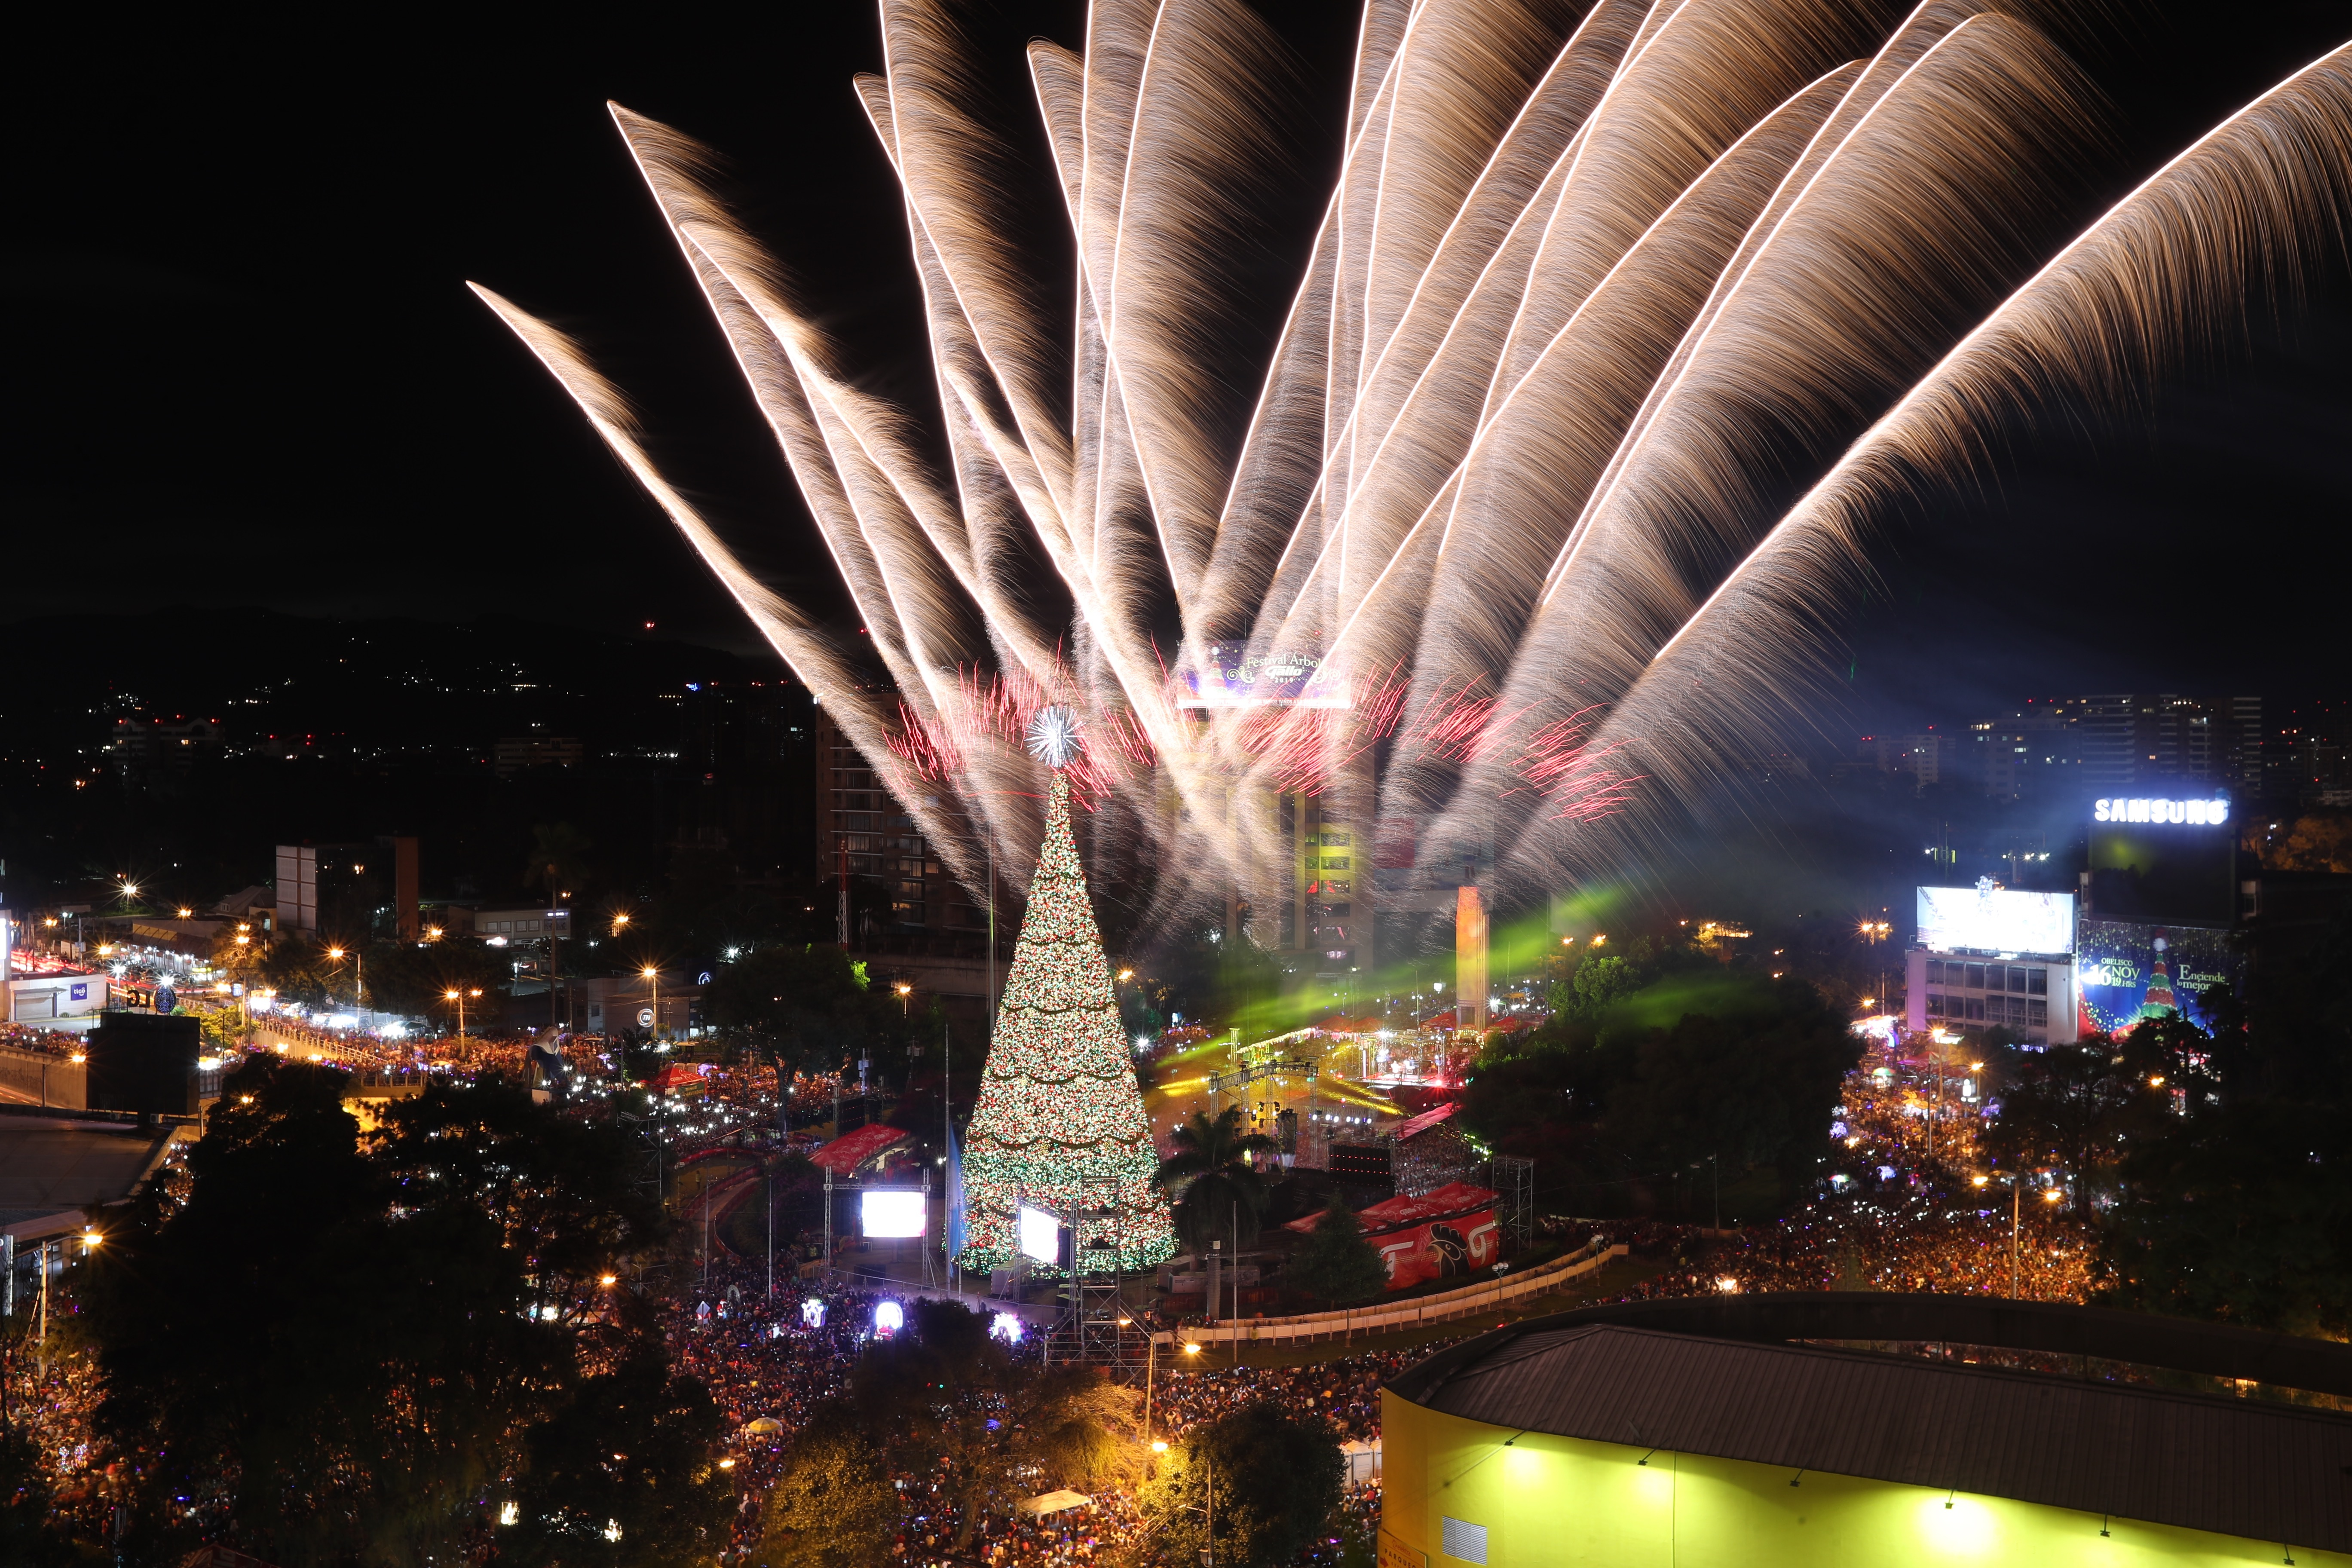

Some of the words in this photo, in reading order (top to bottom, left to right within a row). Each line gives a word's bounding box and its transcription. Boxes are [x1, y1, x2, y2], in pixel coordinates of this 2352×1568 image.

[1246, 654, 1286, 669] Festival
[1290, 652, 1322, 668] Árbol
[1265, 665, 1303, 680] Gallo
[2095, 799, 2225, 825] SAMSUNG
[2101, 958, 2133, 967] OBELISCO
[2090, 964, 2112, 986] 16
[2112, 965, 2140, 980] NOV
[2179, 964, 2226, 983] Enciende
[2122, 980, 2136, 988] HRS
[2183, 980, 2211, 993] mejor
[74, 988, 86, 997] tigo
[1384, 1548, 1416, 1568] PARQUEO
